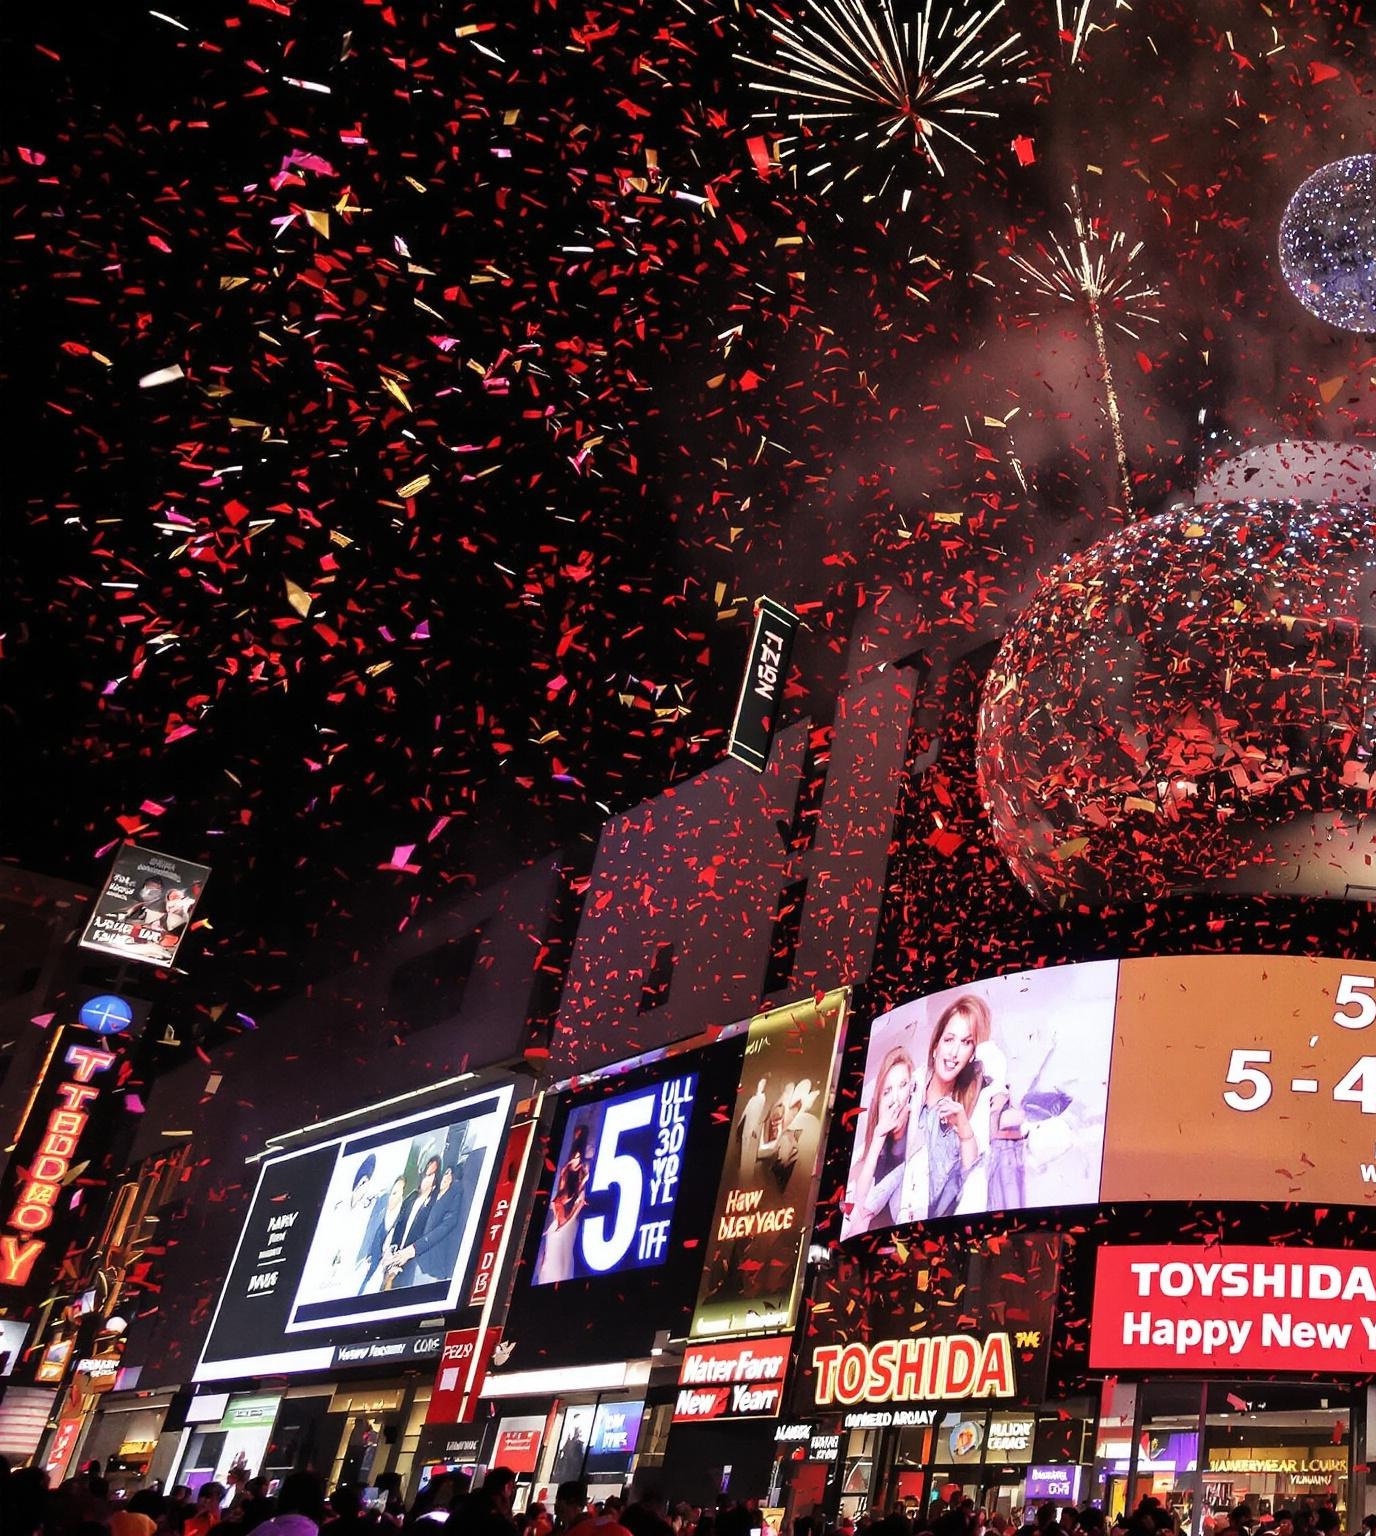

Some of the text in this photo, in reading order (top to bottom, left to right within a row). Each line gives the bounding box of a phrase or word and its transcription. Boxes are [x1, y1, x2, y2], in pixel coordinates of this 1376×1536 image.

[581, 1094, 656, 1272] 5
[1122, 1311, 1253, 1355] Happy
[1261, 1313, 1353, 1349] New
[812, 1332, 1016, 1405] TOSHIDA
[675, 1390, 717, 1415] New
